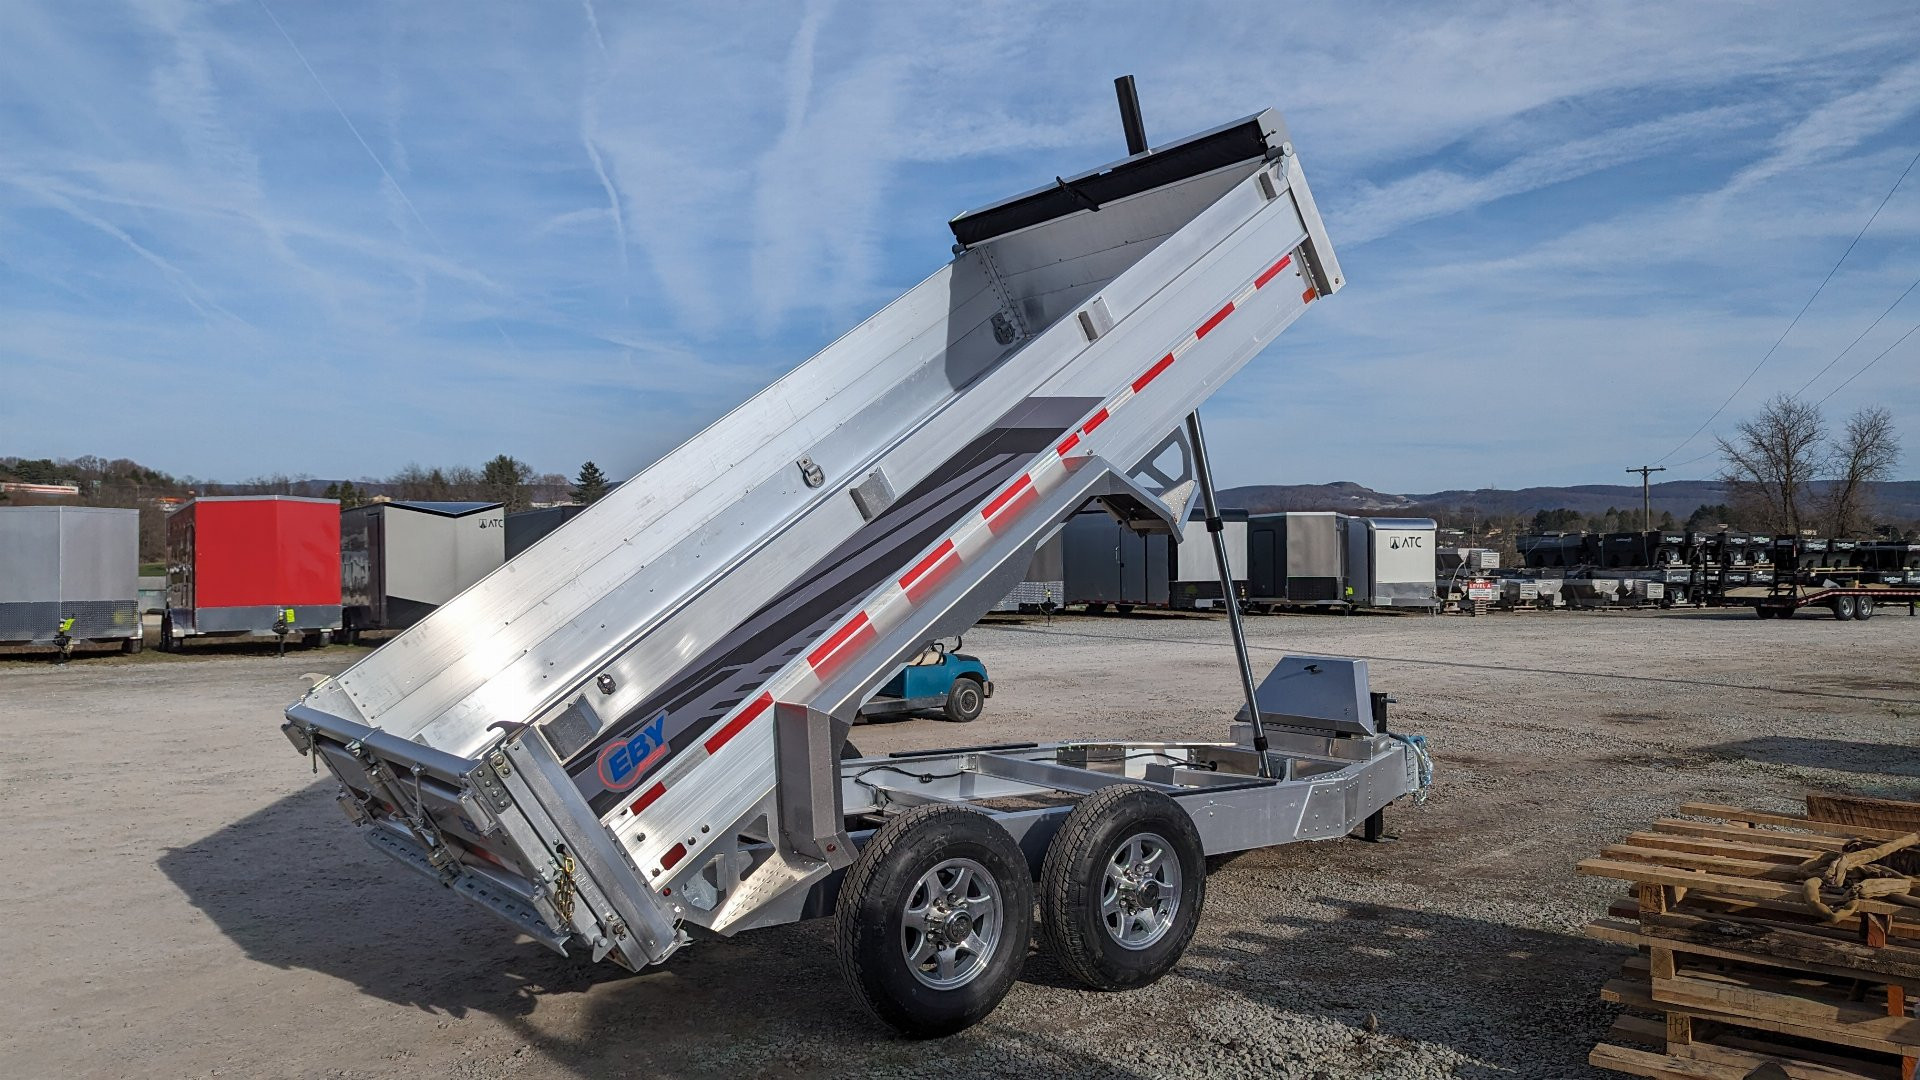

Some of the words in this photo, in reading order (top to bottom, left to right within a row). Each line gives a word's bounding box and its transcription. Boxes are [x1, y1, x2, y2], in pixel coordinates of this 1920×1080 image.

[488, 518, 504, 528] ATC
[1401, 536, 1422, 548] ATC
[608, 715, 665, 783] EBY
